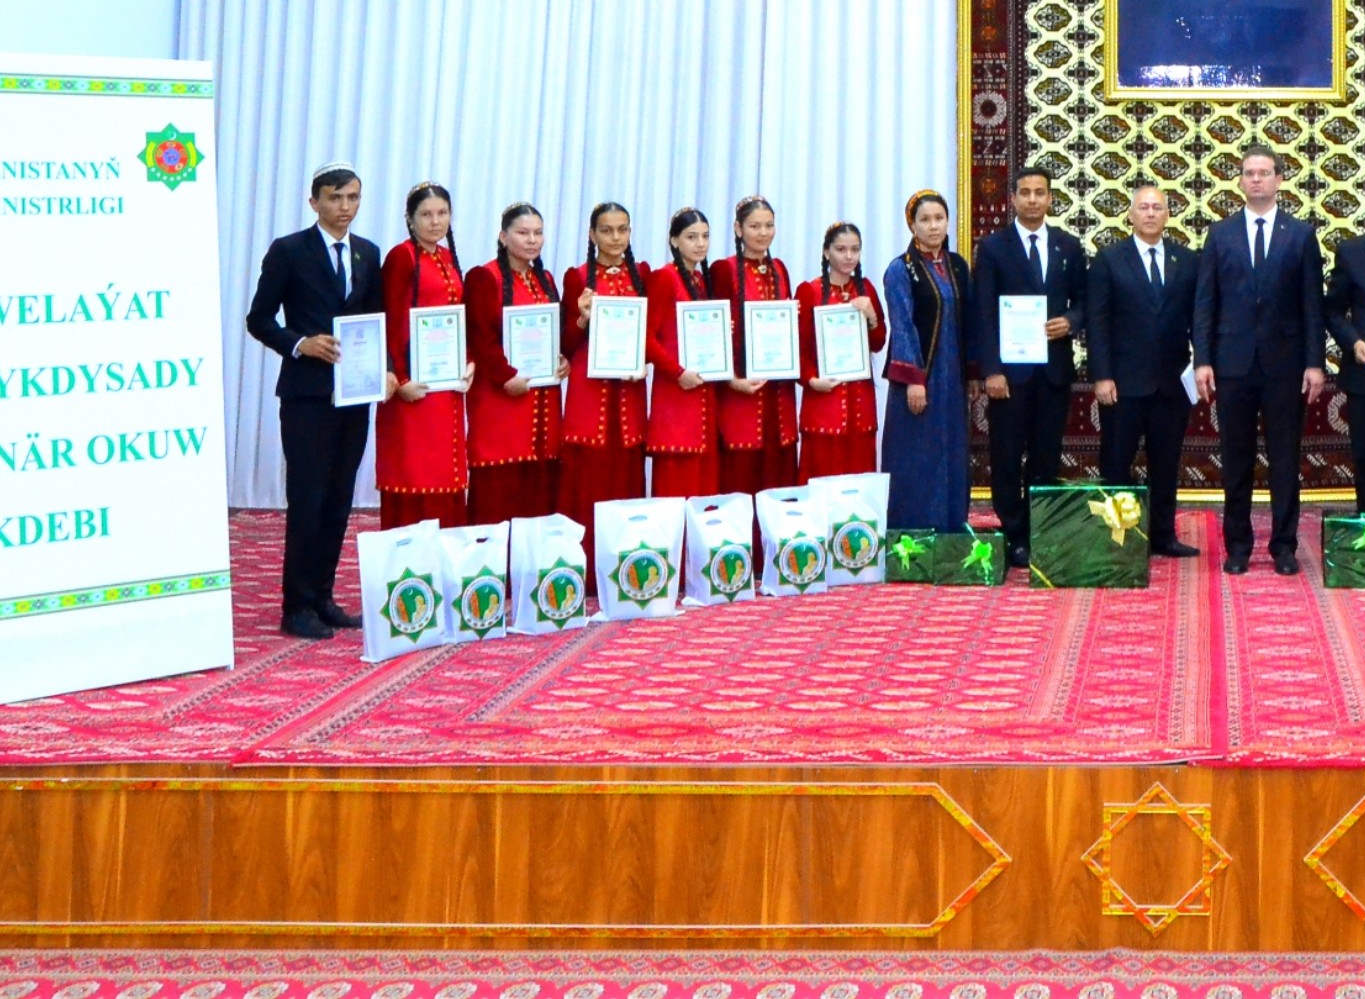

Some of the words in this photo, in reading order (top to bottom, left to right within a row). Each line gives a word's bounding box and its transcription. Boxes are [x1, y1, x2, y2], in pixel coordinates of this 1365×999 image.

[1, 156, 121, 180] NISTANYŇ
[0, 196, 124, 216] NISTRLIGI
[0, 358, 204, 399] YKDYSADY
[87, 426, 208, 465] OKUW
